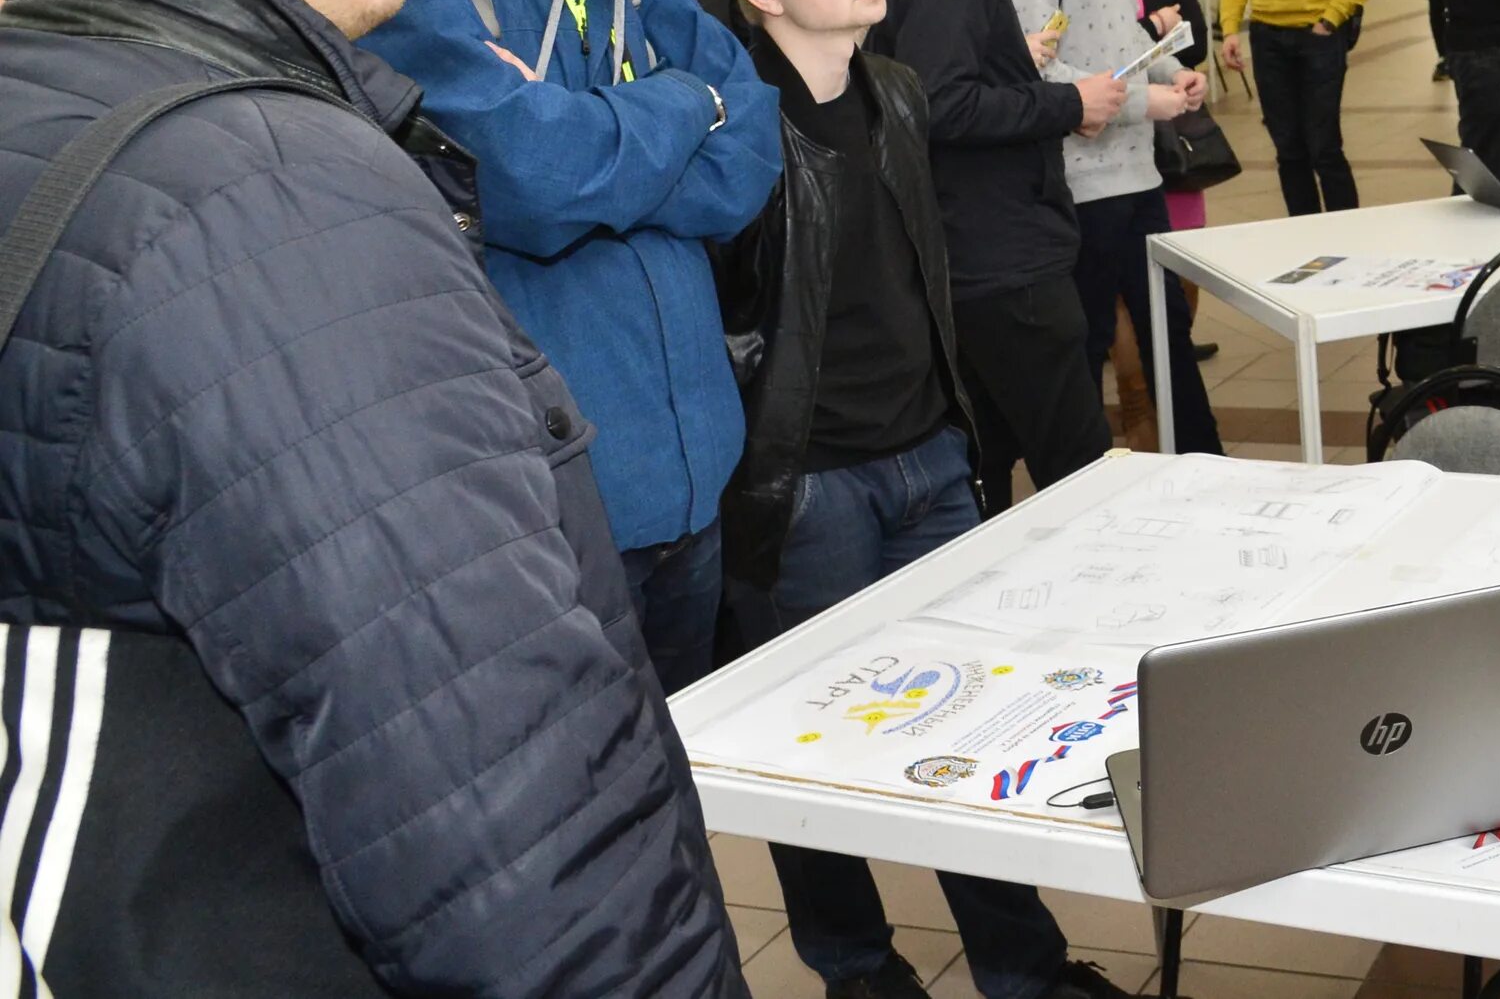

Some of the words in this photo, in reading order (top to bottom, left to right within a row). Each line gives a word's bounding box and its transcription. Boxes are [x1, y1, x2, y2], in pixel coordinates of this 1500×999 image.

[805, 655, 900, 711] СТАРТ
[902, 659, 986, 738] ИНЖЕНЕРНЫЙ
[1367, 713, 1407, 755] hp
